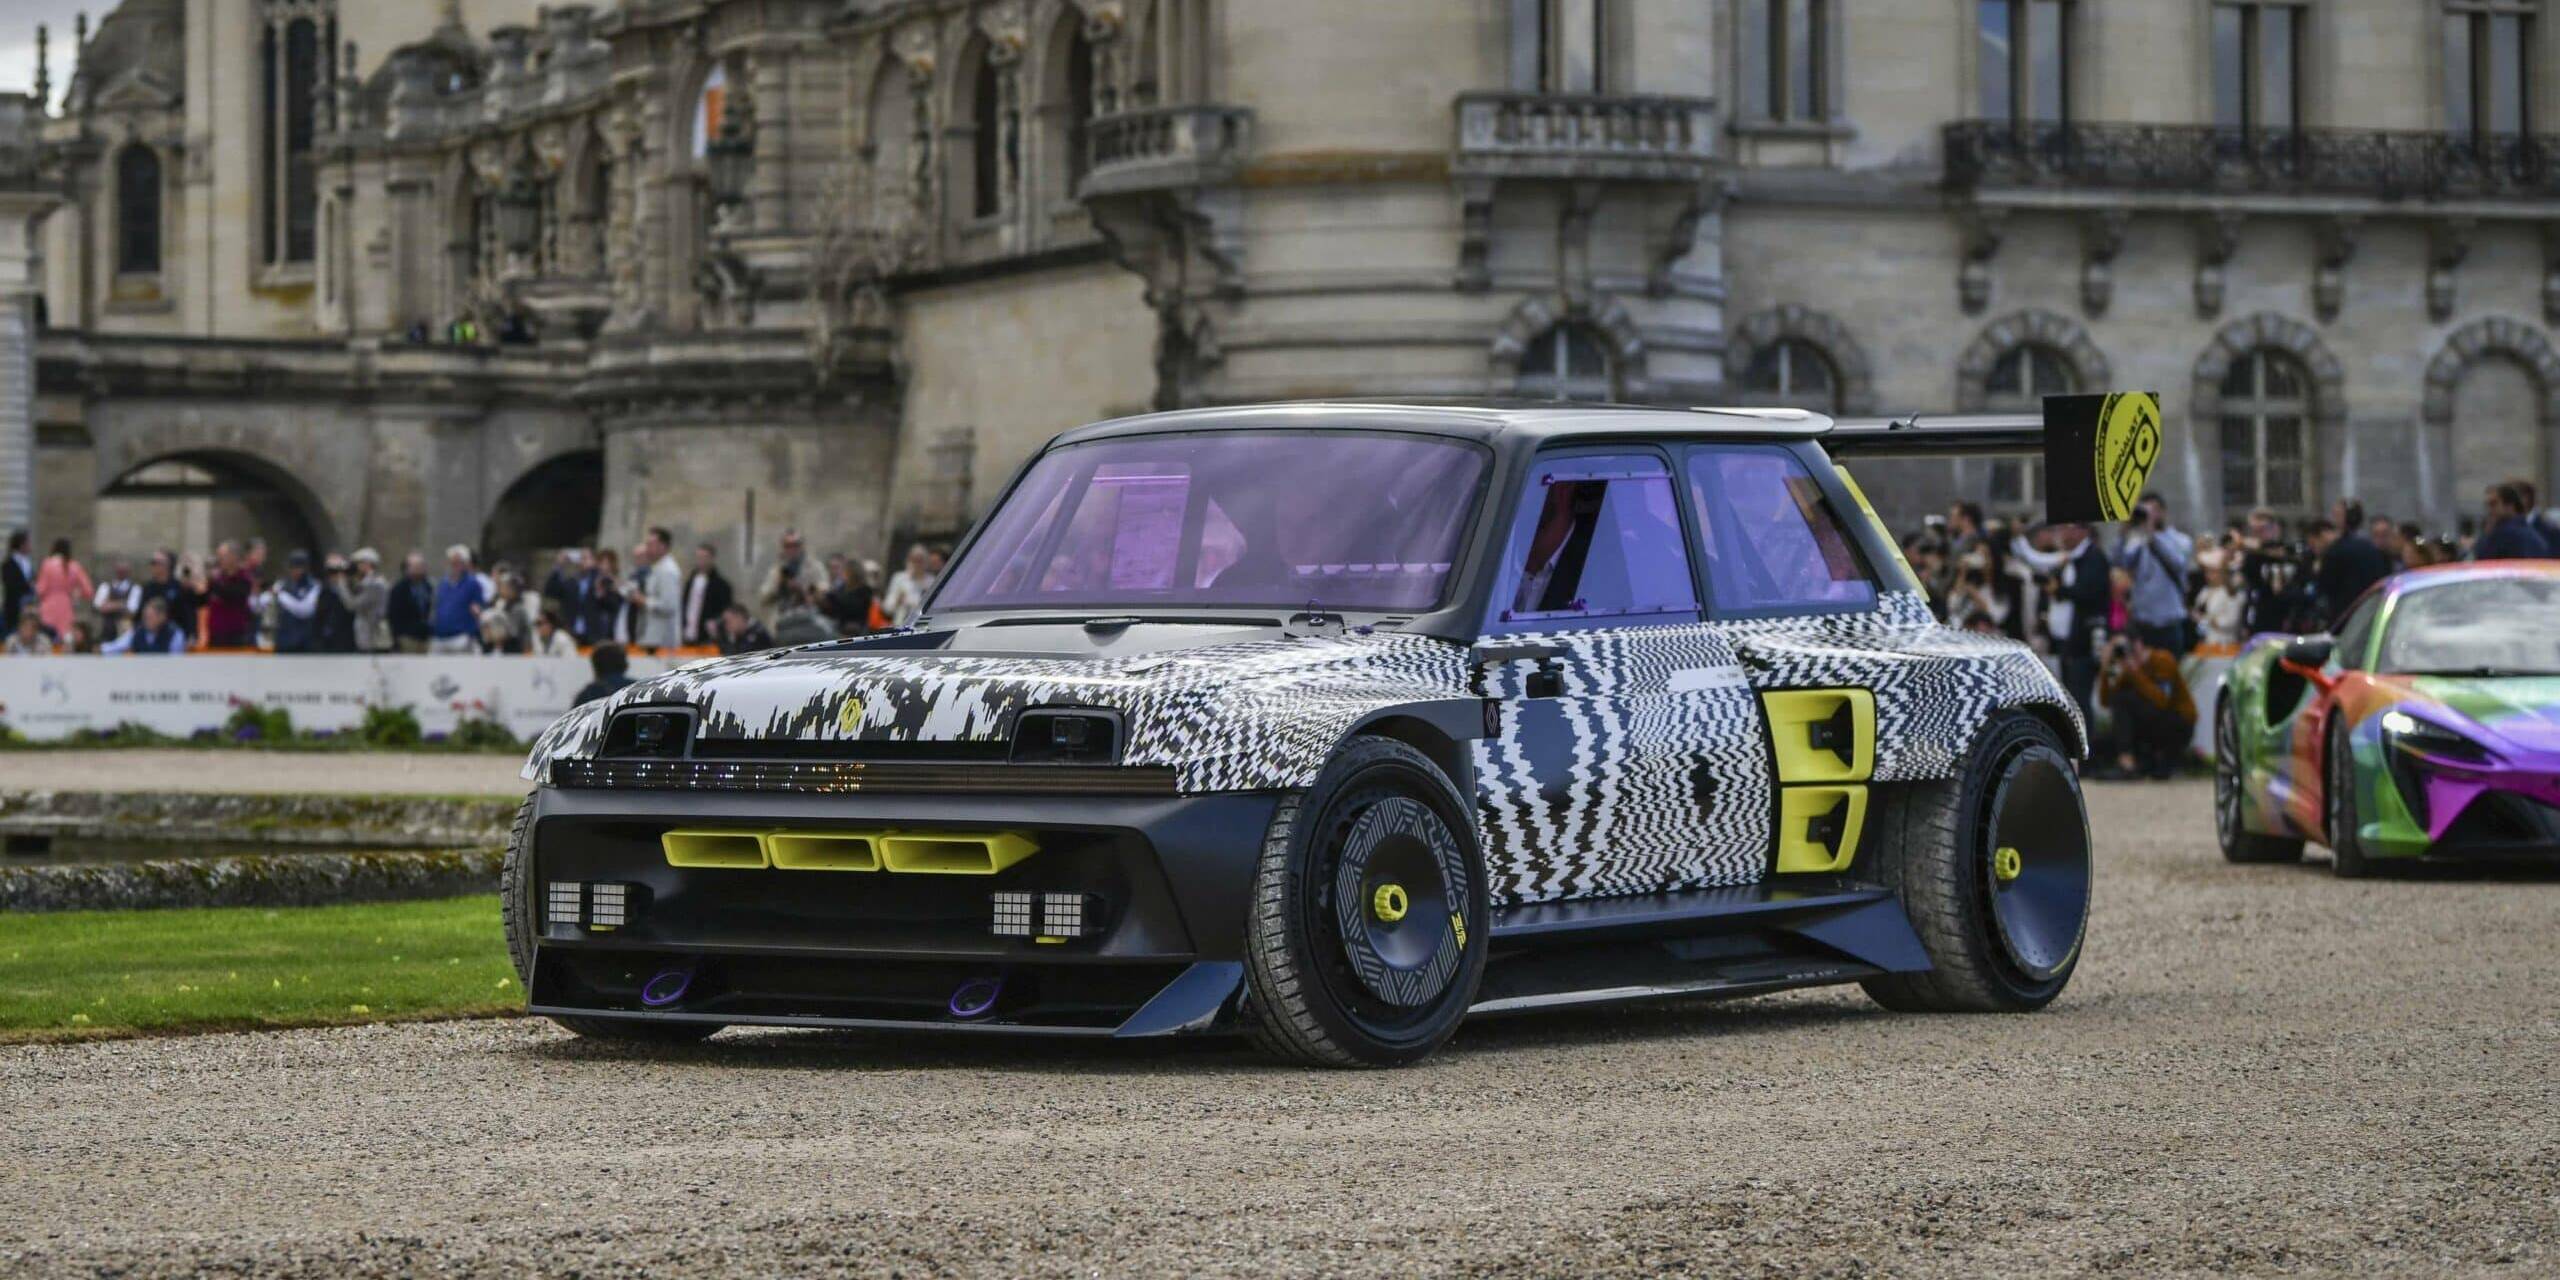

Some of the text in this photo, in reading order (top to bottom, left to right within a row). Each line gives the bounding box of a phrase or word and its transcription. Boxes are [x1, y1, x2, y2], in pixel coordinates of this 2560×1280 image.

[2110, 415, 2139, 481] RENAULT
[2115, 412, 2159, 514] 50
[1424, 809, 1458, 912] TURBO
